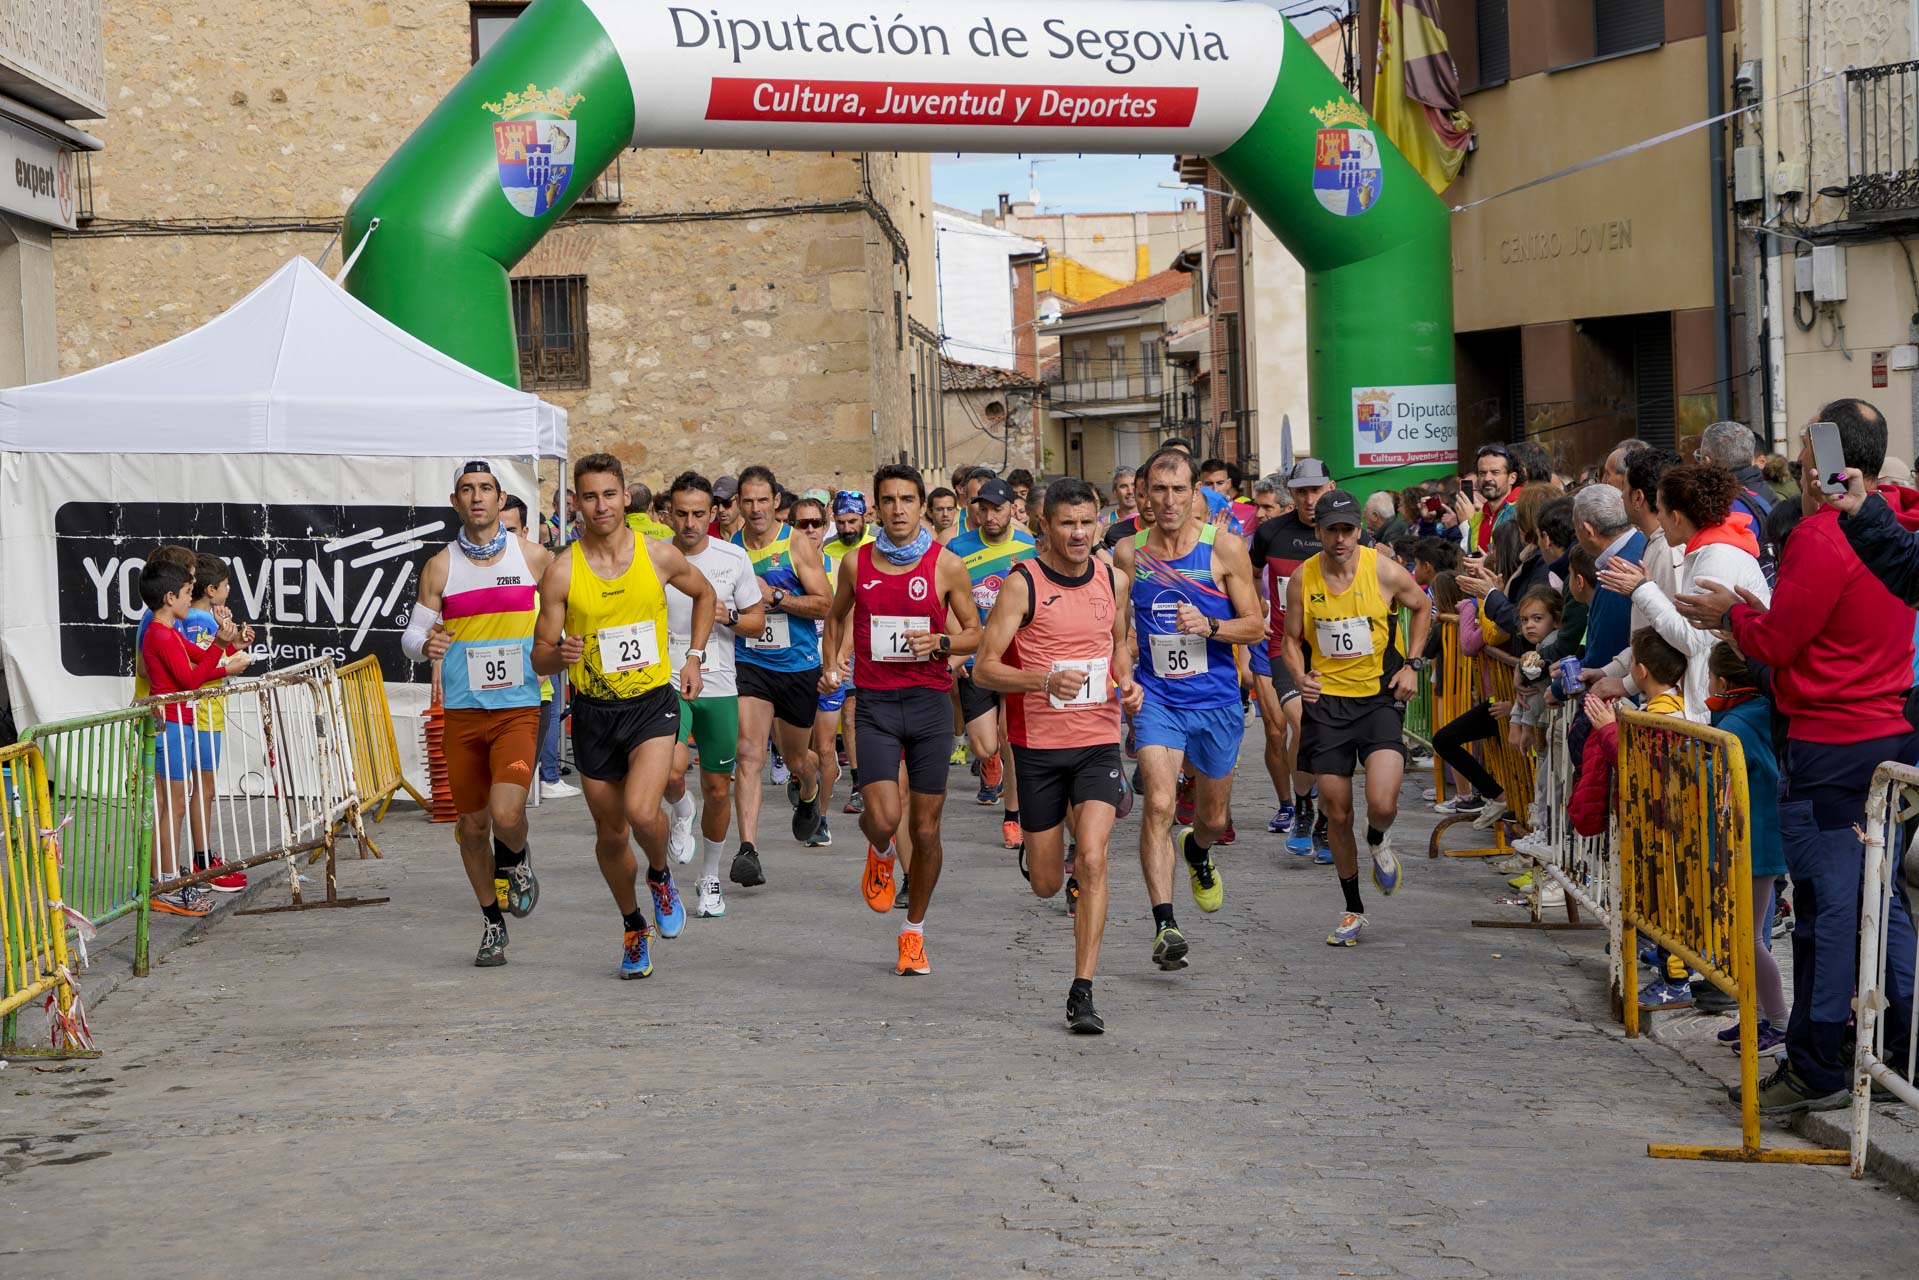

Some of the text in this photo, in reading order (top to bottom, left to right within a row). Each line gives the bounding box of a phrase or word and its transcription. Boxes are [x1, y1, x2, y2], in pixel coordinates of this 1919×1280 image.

[667, 7, 1229, 74] Diputación de Segovia
[753, 82, 1158, 123] Cultura, Juventud y Deportes
[15, 157, 56, 199] expert
[1501, 232, 1561, 264] CENTRO
[1570, 218, 1632, 255] JOVEN
[1397, 423, 1419, 440] de
[496, 576, 521, 585] 226ERS
[619, 639, 642, 662] 23
[1331, 633, 1353, 651] 76
[485, 660, 507, 681] 95
[1168, 650, 1189, 671] 56
